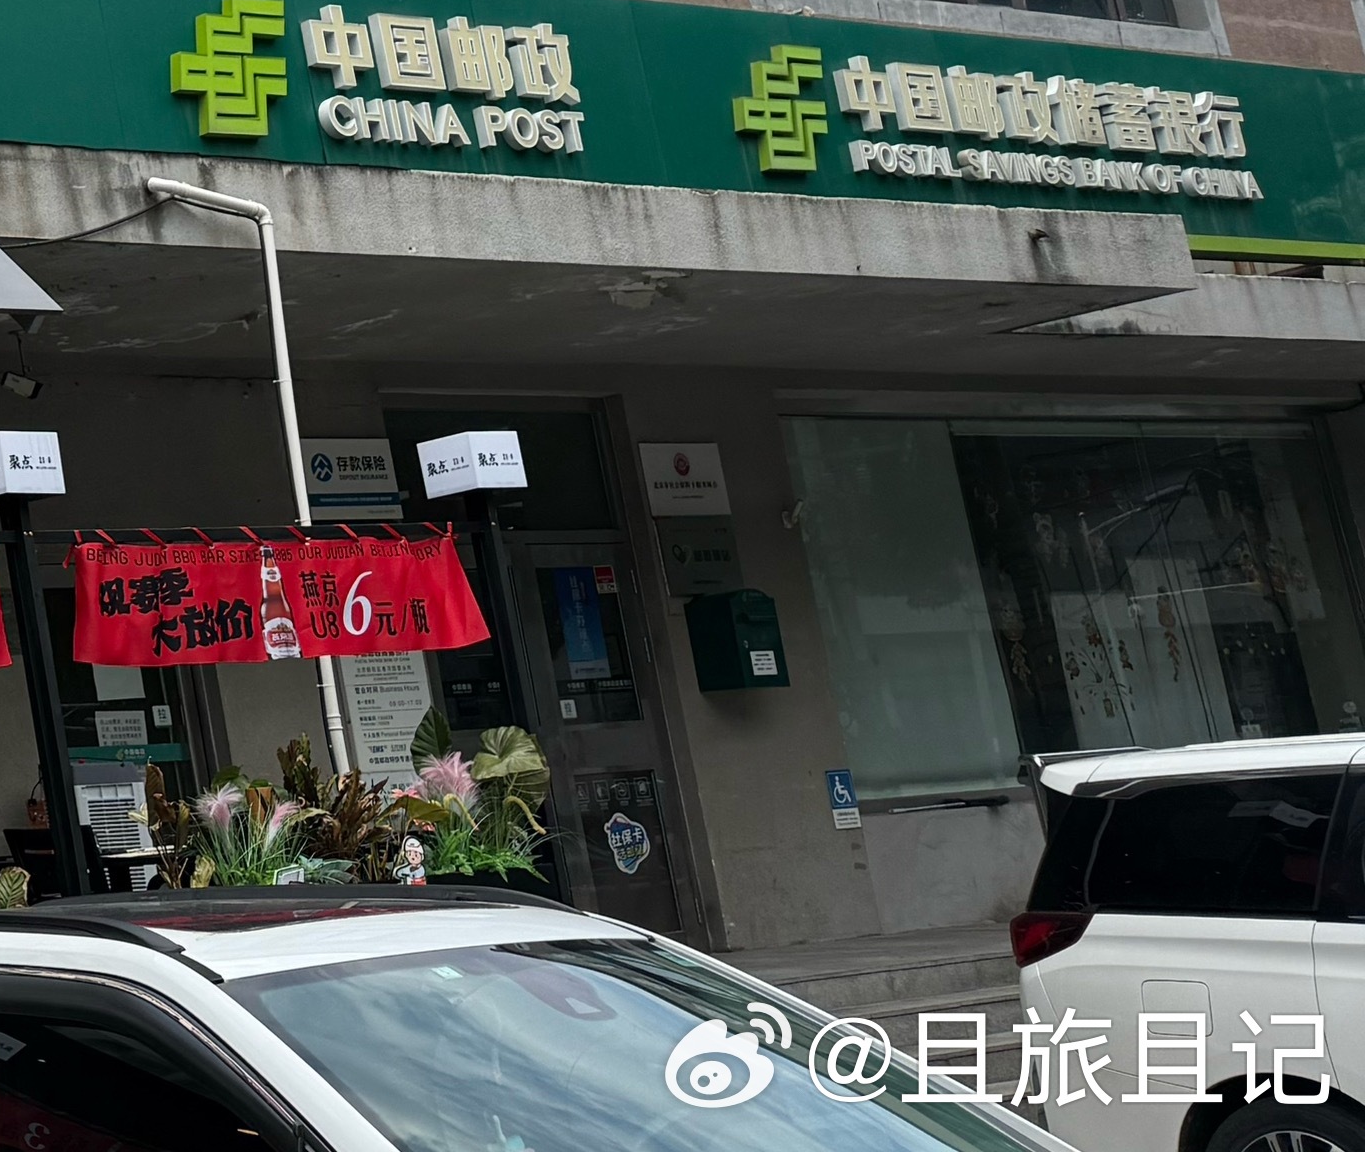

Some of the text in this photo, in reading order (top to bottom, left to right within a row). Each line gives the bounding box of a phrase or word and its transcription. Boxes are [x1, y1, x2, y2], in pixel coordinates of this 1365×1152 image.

[301, 3, 580, 108] 中国邮政
[318, 94, 585, 154] CHINA POST
[833, 54, 1246, 159] 中国邮政储蓄银行
[848, 139, 1264, 201] POSTAL SAVINGS BANK OF CHINA
[9, 454, 33, 470] 聚点
[336, 456, 386, 471] 存款保险
[298, 547, 322, 560] OUR
[299, 570, 341, 608] 燕京
[152, 598, 254, 657] 大放价
[310, 610, 341, 639] U8
